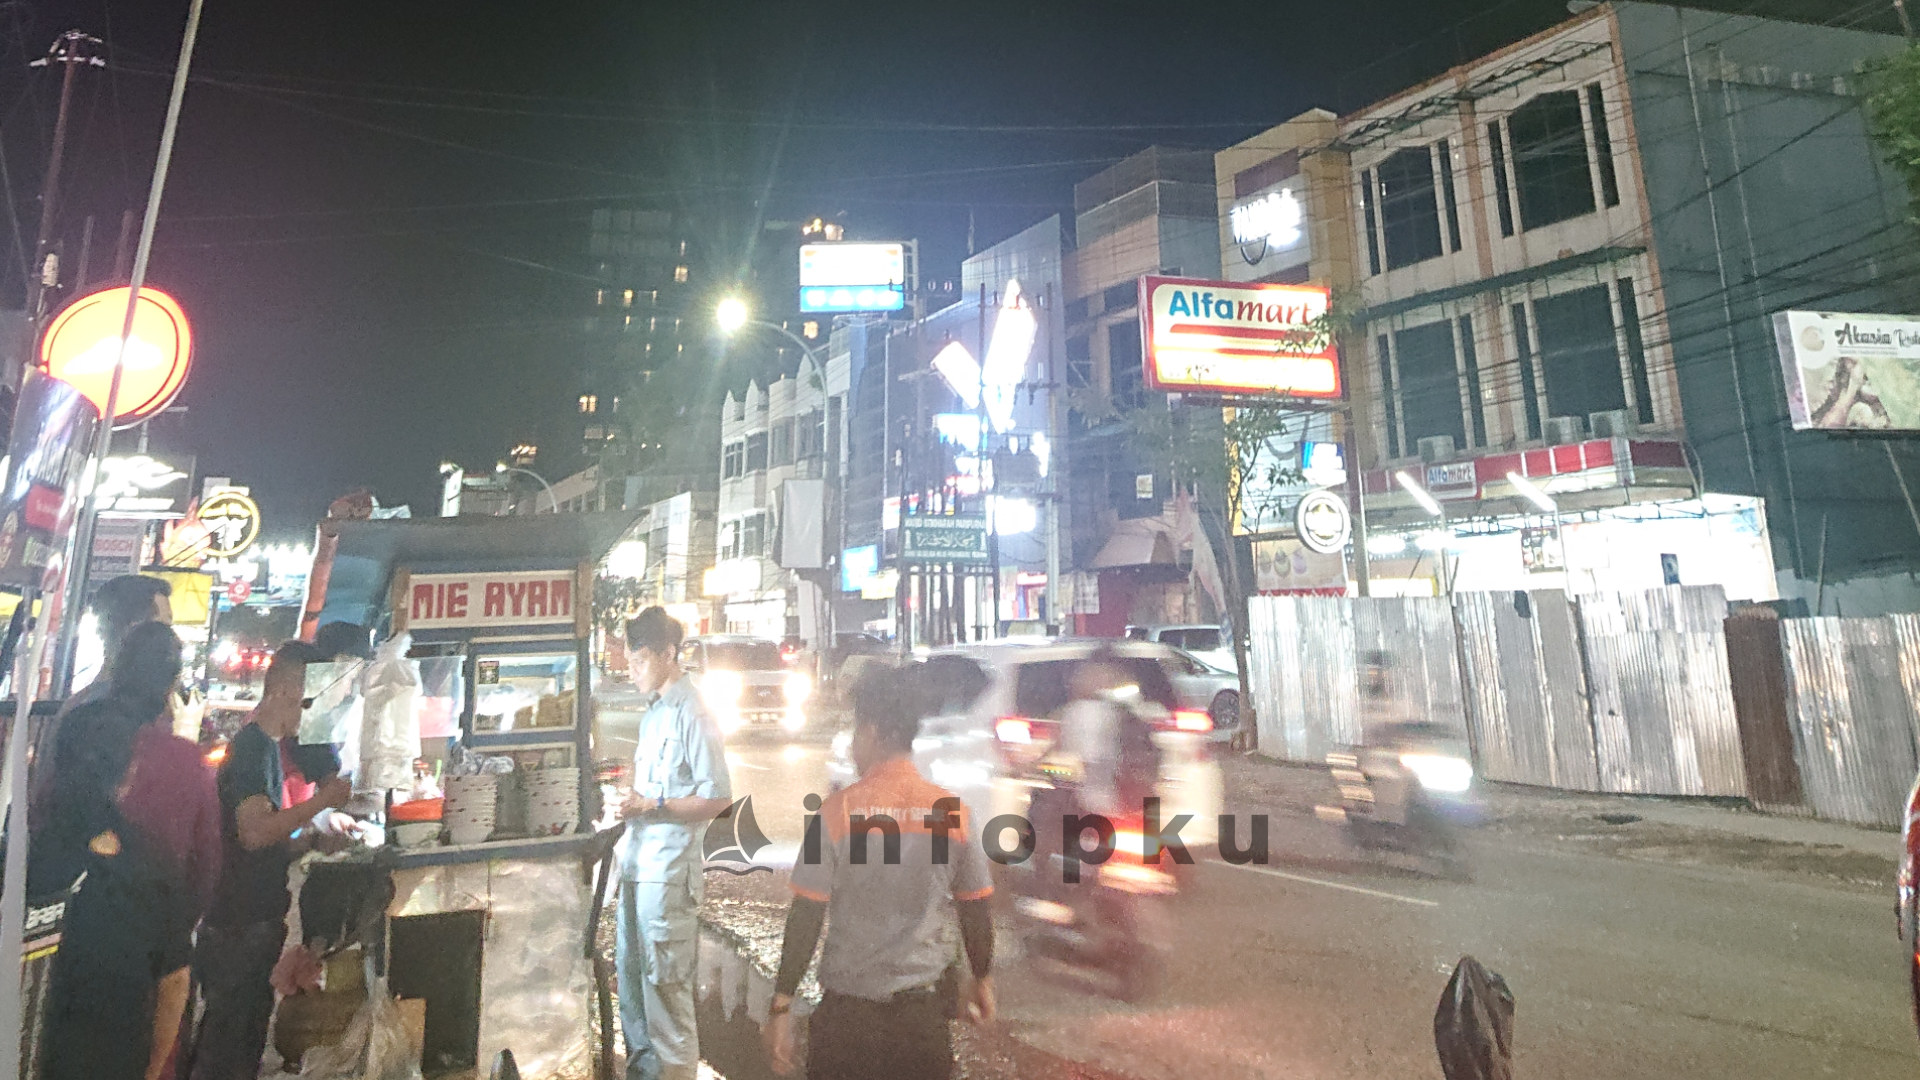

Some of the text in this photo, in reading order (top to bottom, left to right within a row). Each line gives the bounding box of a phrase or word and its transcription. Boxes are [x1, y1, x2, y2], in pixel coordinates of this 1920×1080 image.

[1168, 290, 1316, 326] Alfamart
[1834, 322, 1893, 345] Akasia
[1428, 466, 1472, 482] Alfamart
[94, 538, 133, 552] BOSCH
[411, 579, 572, 620] MIE AYAM
